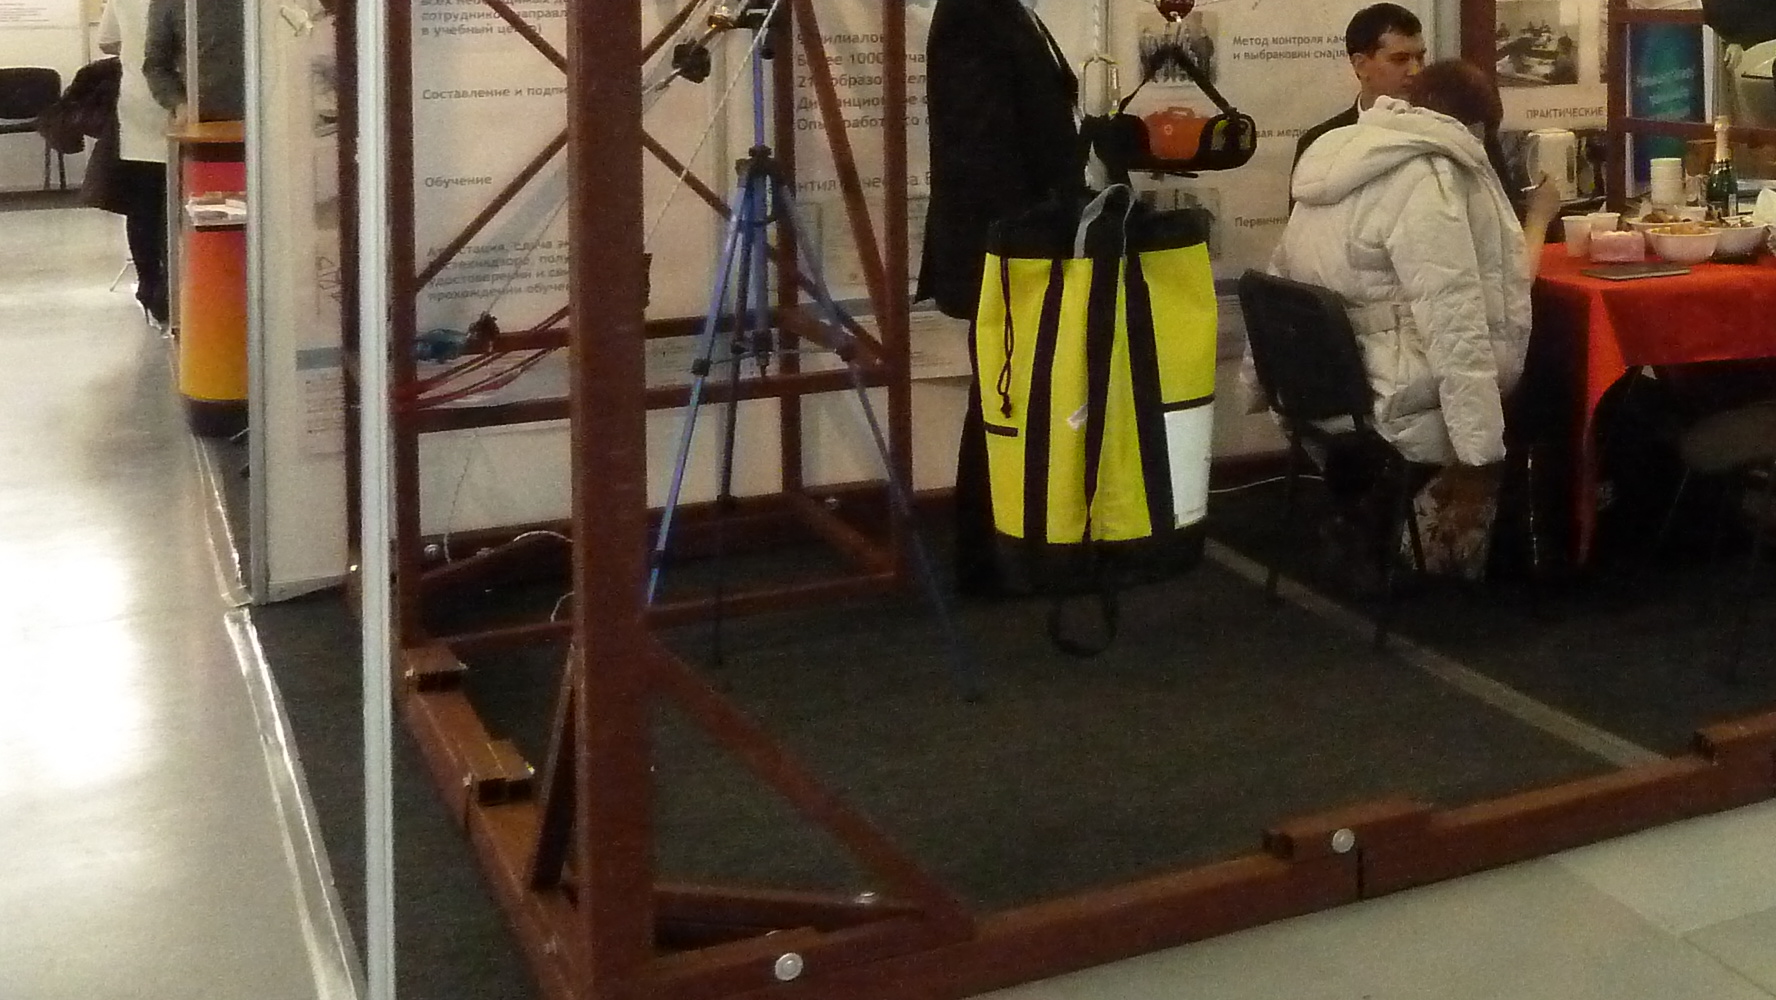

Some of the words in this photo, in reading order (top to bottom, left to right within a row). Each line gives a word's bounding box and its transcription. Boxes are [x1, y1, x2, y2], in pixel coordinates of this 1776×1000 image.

[422, 86, 511, 101] Составление
[1526, 106, 1605, 120] ПРАКТИЧЕСКИЕ
[424, 174, 493, 189] Обучение
